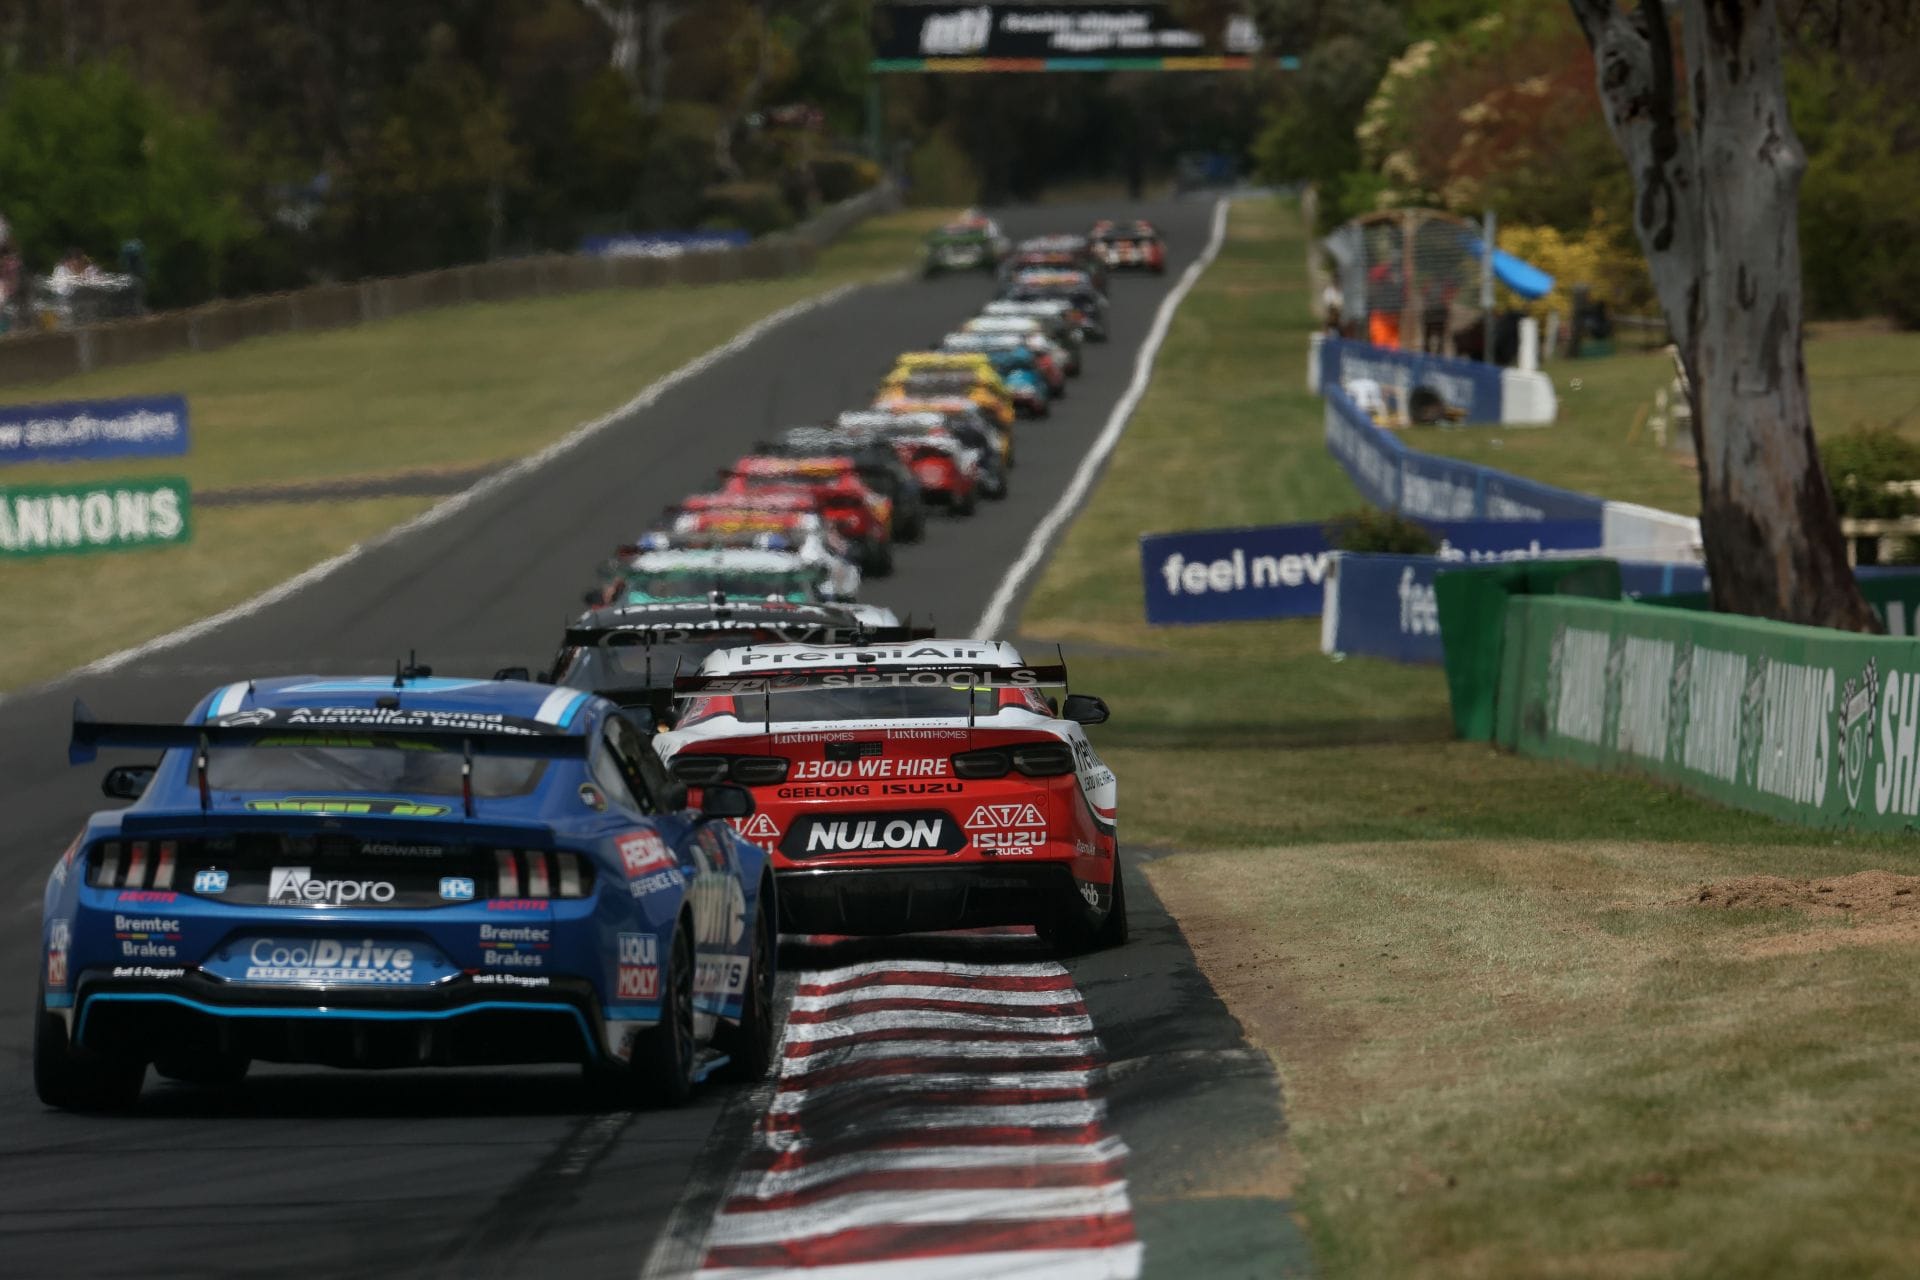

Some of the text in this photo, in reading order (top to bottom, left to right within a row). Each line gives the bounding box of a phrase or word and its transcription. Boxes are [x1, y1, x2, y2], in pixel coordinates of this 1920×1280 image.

[1162, 549, 1245, 595] feel
[598, 627, 860, 647] GRVE
[288, 713, 424, 726] Australian
[292, 707, 504, 722] A family owned
[794, 758, 948, 779] 1300 WE HIRE
[777, 782, 964, 799] GEELONG ISUZU
[806, 817, 944, 851] NULON
[972, 831, 1047, 849] ISUZU
[274, 869, 396, 904] Aerpro
[115, 914, 180, 931] Bremtec
[480, 924, 549, 941] Bremtec
[122, 940, 176, 957] Brakes
[251, 938, 414, 968] CoolDrive
[484, 950, 543, 967] Brakes
